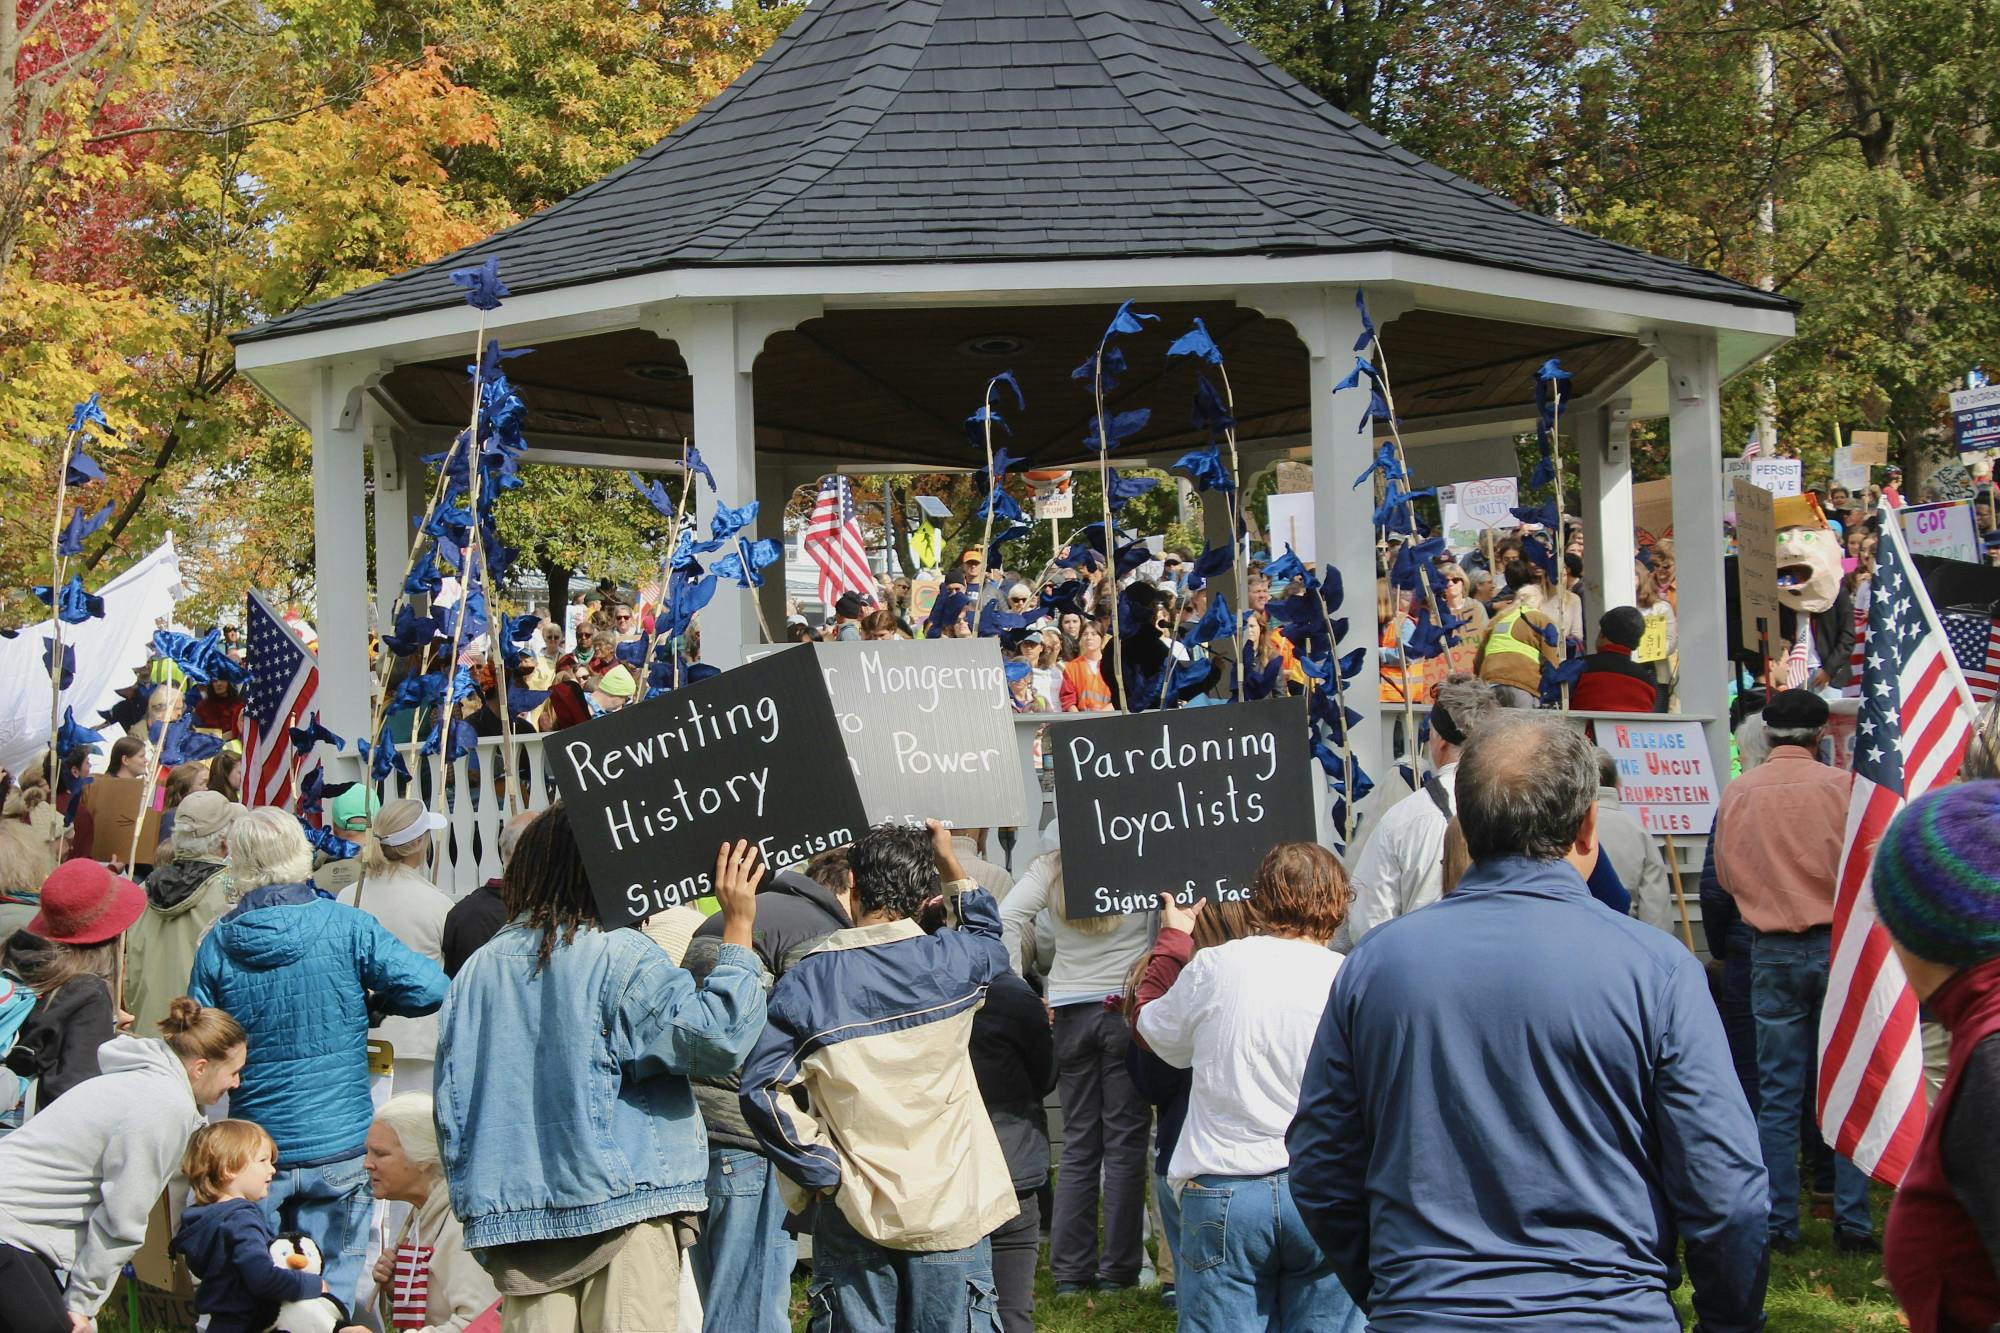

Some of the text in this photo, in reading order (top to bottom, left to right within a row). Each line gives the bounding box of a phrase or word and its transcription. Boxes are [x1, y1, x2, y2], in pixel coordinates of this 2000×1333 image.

[1958, 413, 1973, 423] NO
[1961, 426, 2000, 438] AMERIC
[1975, 420, 1988, 428] IN
[1756, 464, 1799, 476] PERSIST
[859, 651, 1006, 714] Mongering
[565, 696, 780, 792] Rewriting
[893, 731, 1001, 775] Power
[1068, 724, 1278, 782] Pardoning
[1616, 759, 1641, 776] HE
[604, 766, 770, 851] History
[1094, 774, 1266, 858] loyalists
[626, 827, 853, 918] Signs Facism
[1094, 878, 1260, 915] Signs of Fac
